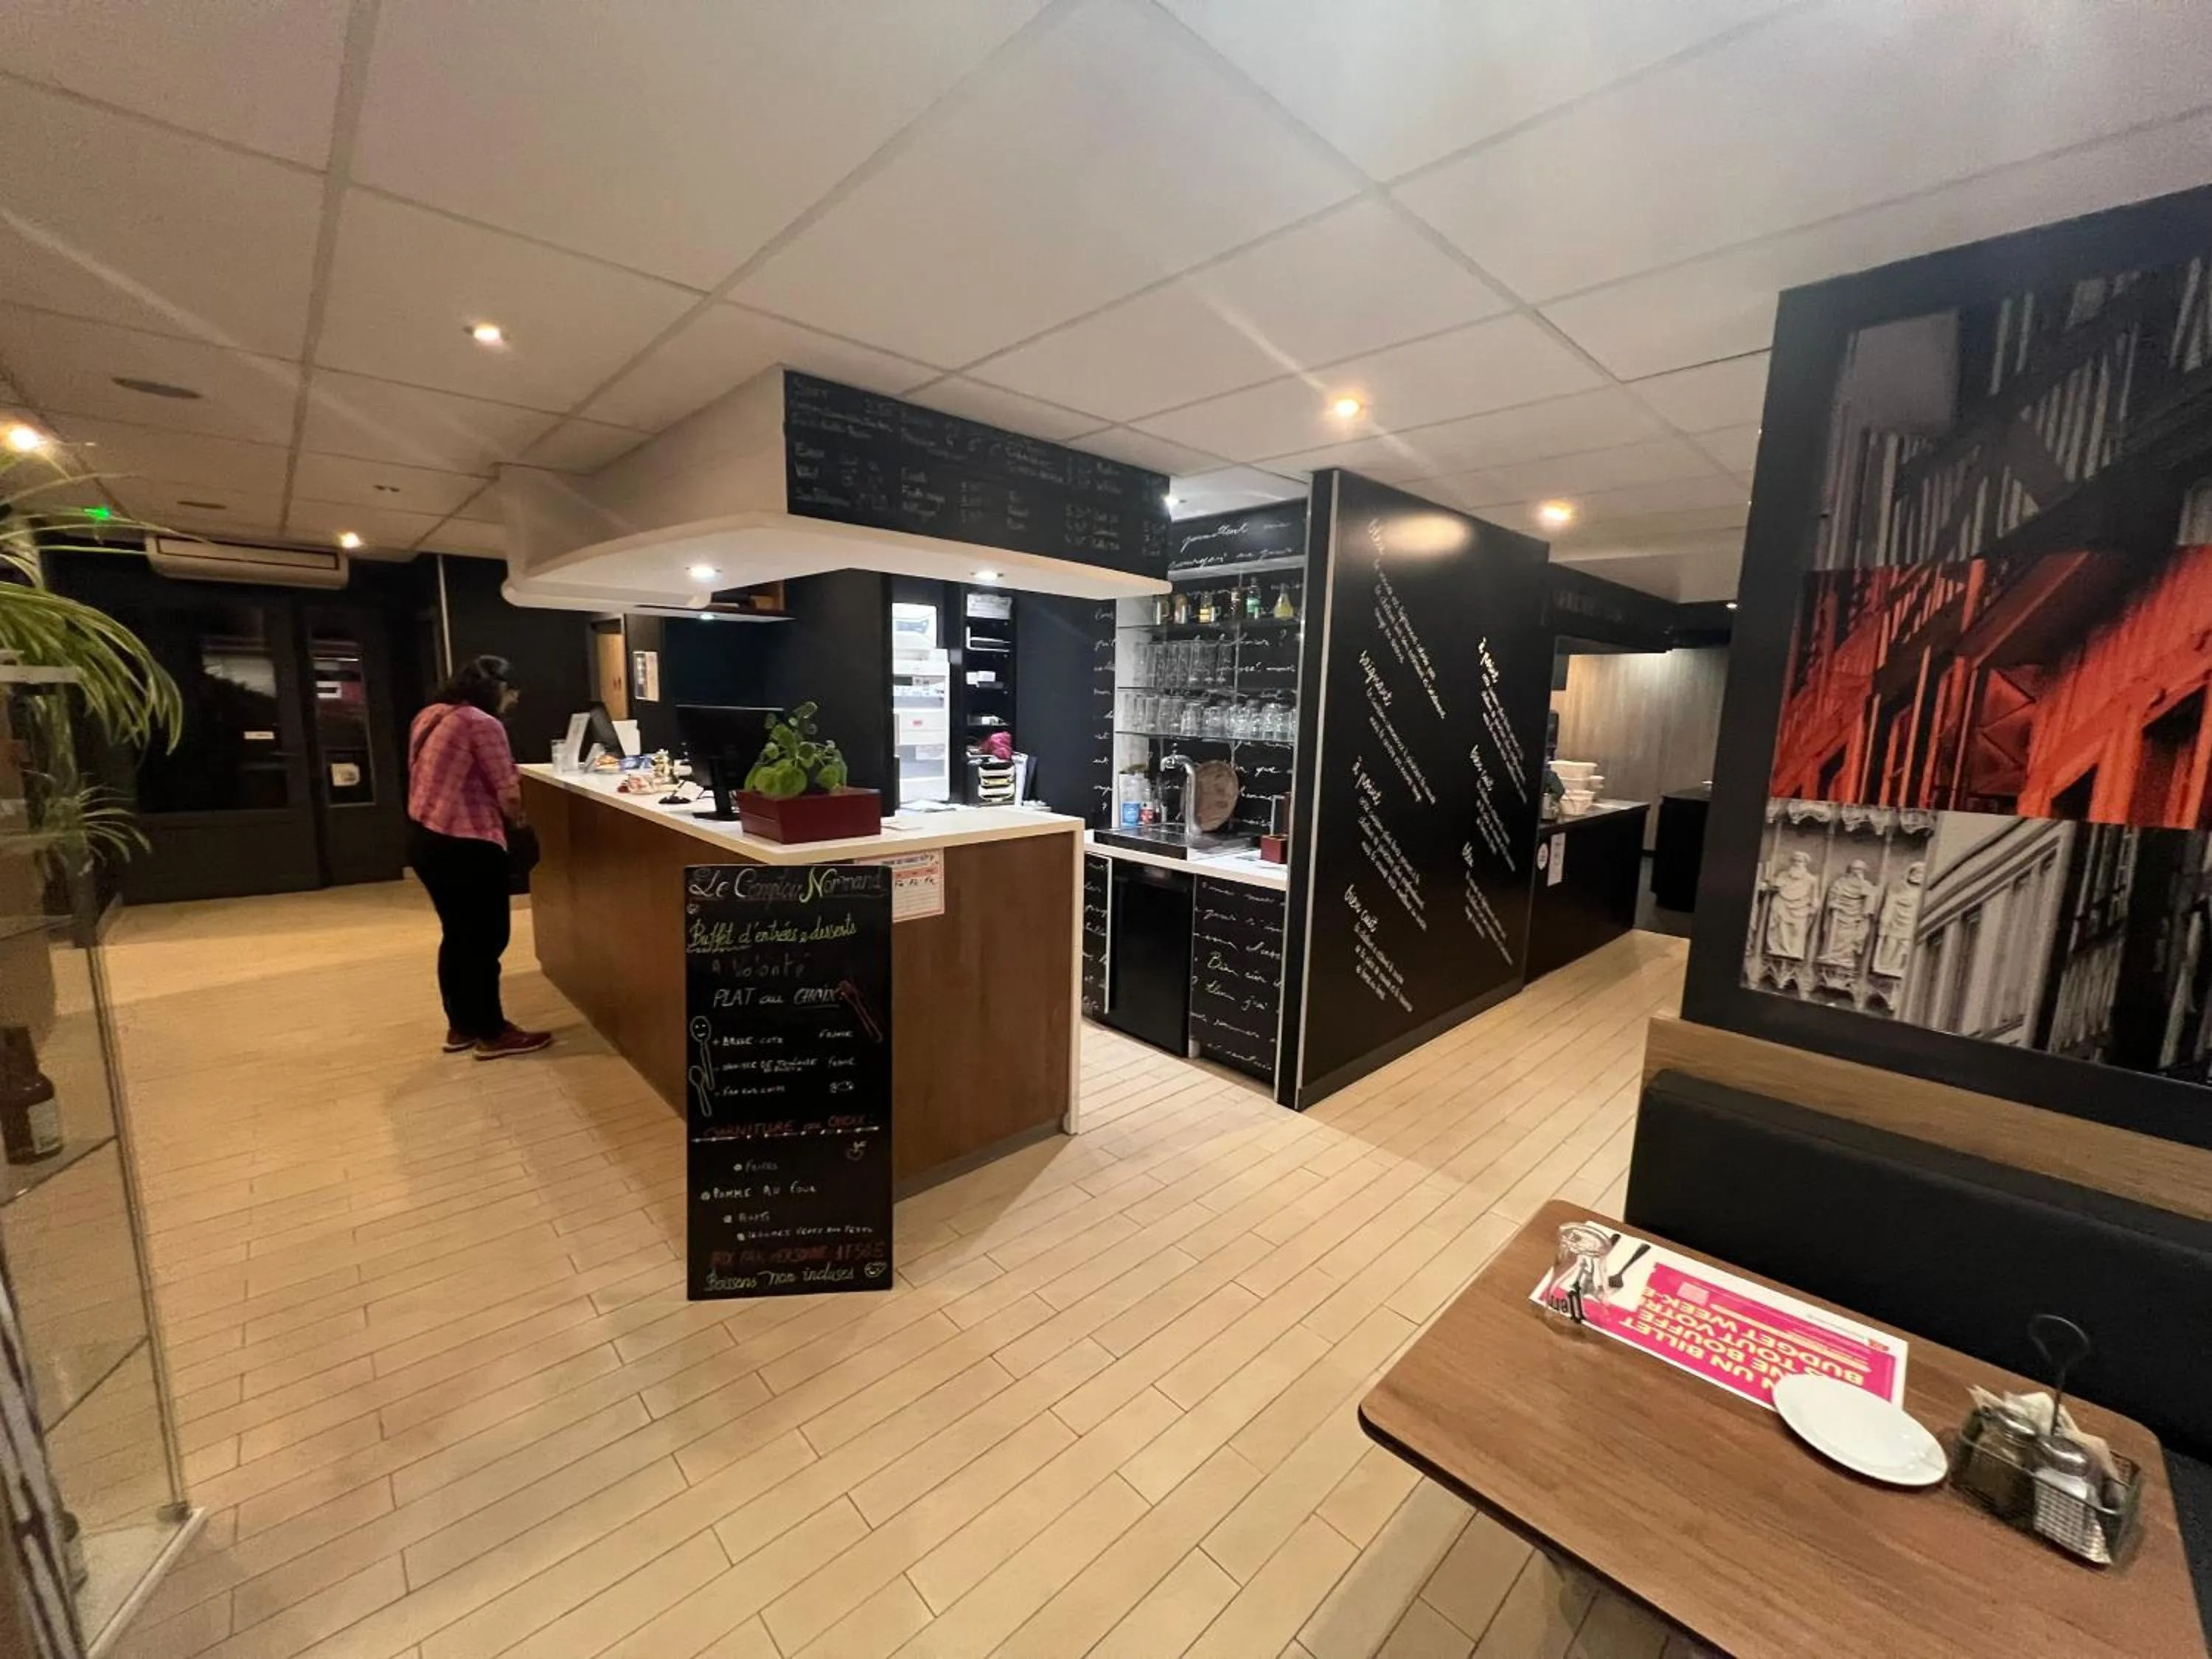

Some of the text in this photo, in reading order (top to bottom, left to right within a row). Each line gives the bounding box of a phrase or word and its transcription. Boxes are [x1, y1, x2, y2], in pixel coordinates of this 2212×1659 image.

[689, 870, 728, 898] Le
[713, 987, 756, 1008] PLAT
[1642, 1287, 1739, 1333] WEEK-E
[1618, 1317, 1705, 1359] BILLET
[1638, 1309, 1745, 1363] BOUFFE
[1716, 1332, 1798, 1373] TOUT
[1711, 1354, 1754, 1382] UN
[1741, 1329, 1865, 1386] BUDGET
